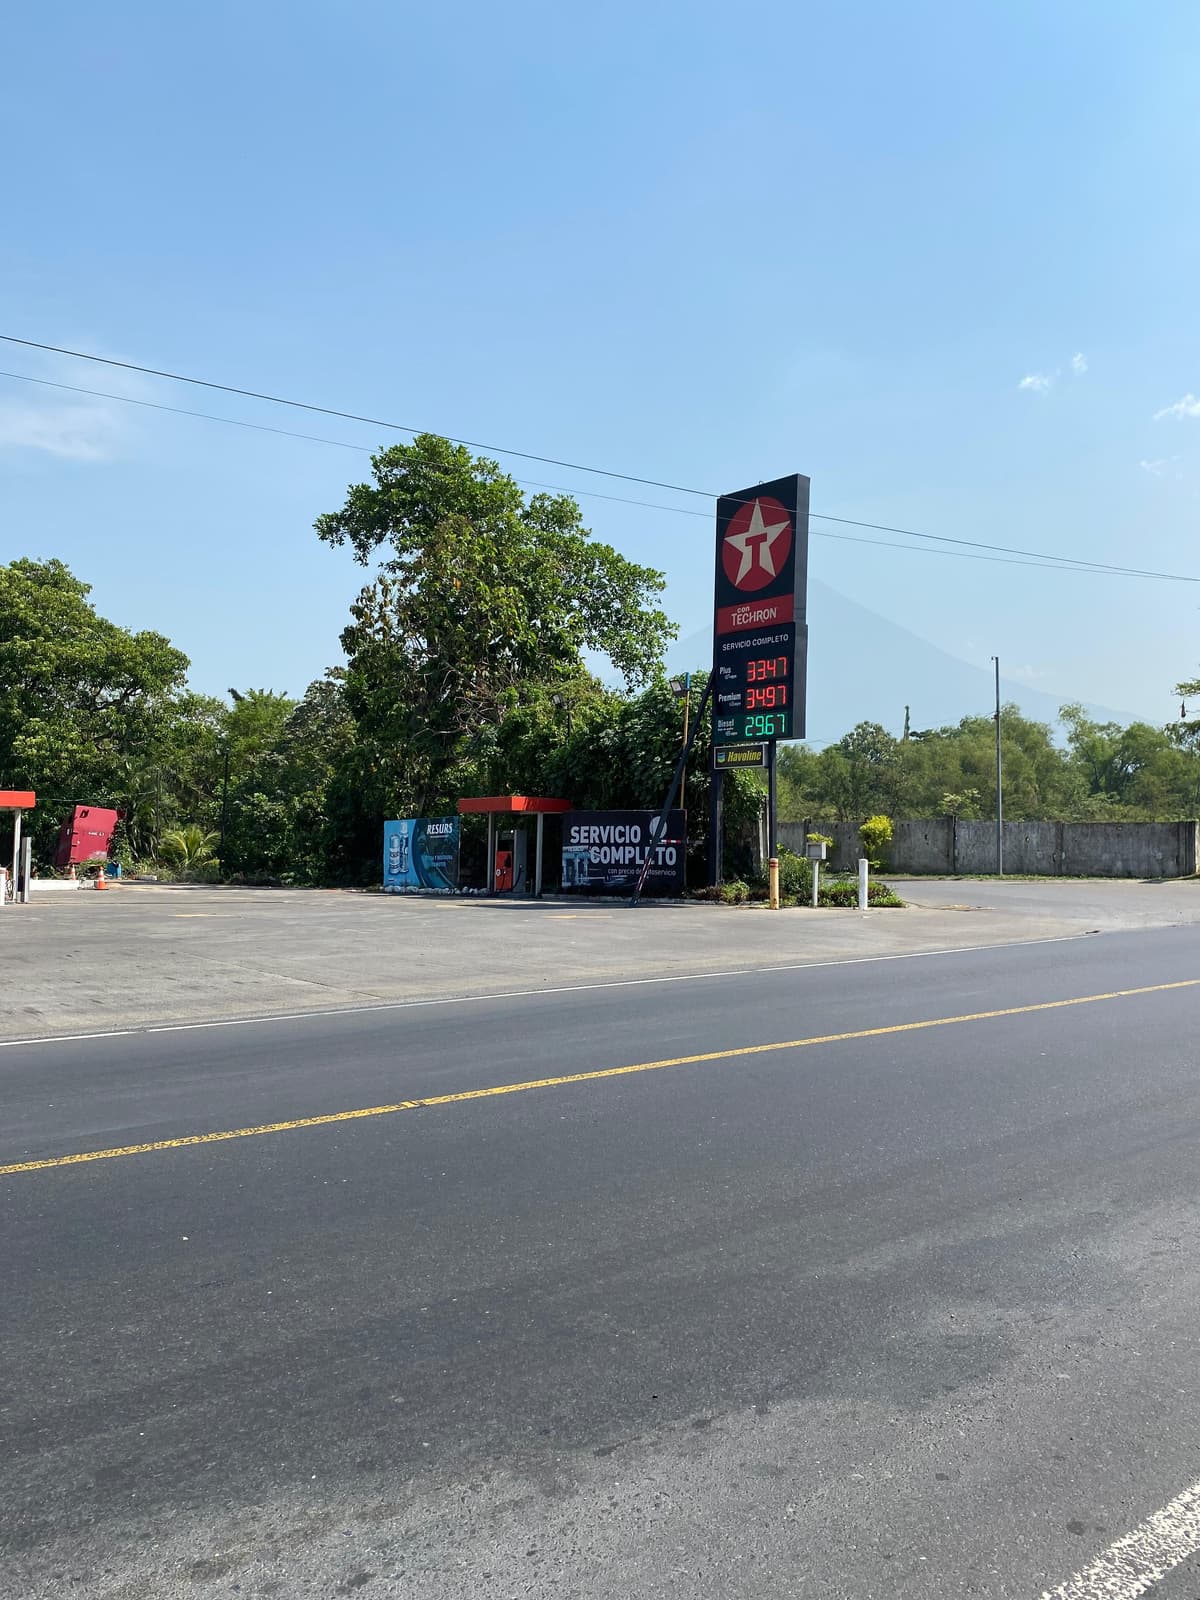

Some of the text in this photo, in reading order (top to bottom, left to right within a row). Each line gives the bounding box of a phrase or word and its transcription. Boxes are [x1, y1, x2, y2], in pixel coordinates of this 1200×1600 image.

[731, 607, 777, 627] TECHRON
[722, 633, 789, 651] SERVICIO COMPLETO
[719, 666, 731, 674] Plus
[718, 692, 741, 702] Premium
[717, 718, 735, 728] Diesel
[727, 750, 762, 762] Havoline
[570, 825, 641, 844] SERVICIO
